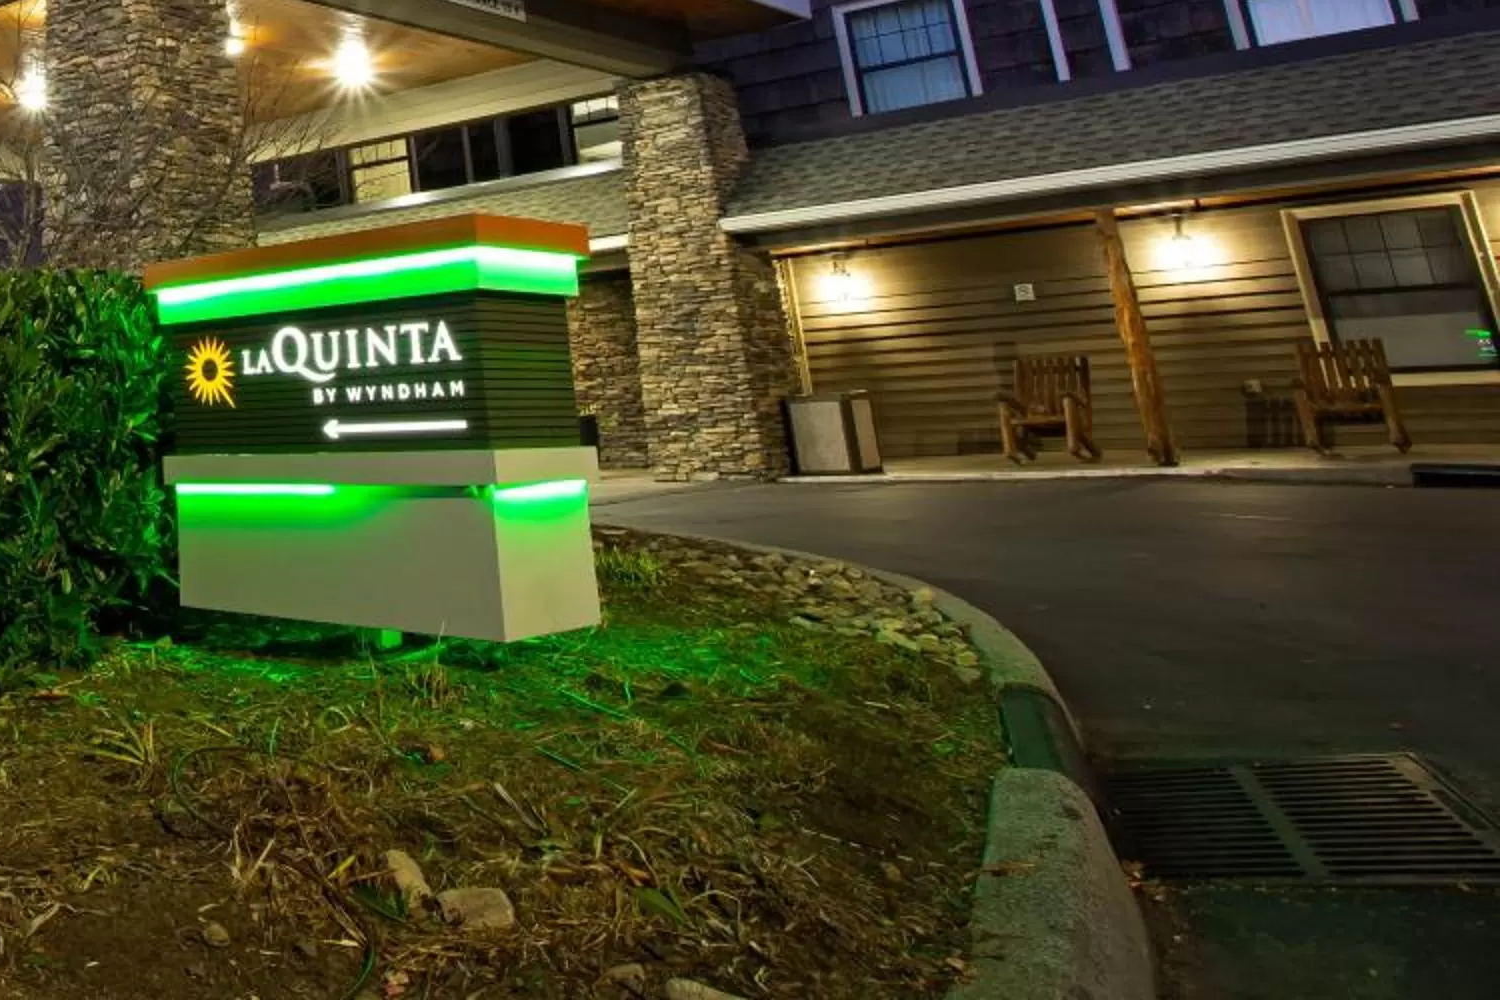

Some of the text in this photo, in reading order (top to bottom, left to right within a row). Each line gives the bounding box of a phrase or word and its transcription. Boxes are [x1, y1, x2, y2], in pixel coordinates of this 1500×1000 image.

[241, 320, 463, 383] LA QUINTA
[312, 380, 464, 404] BY WYNDHAM
